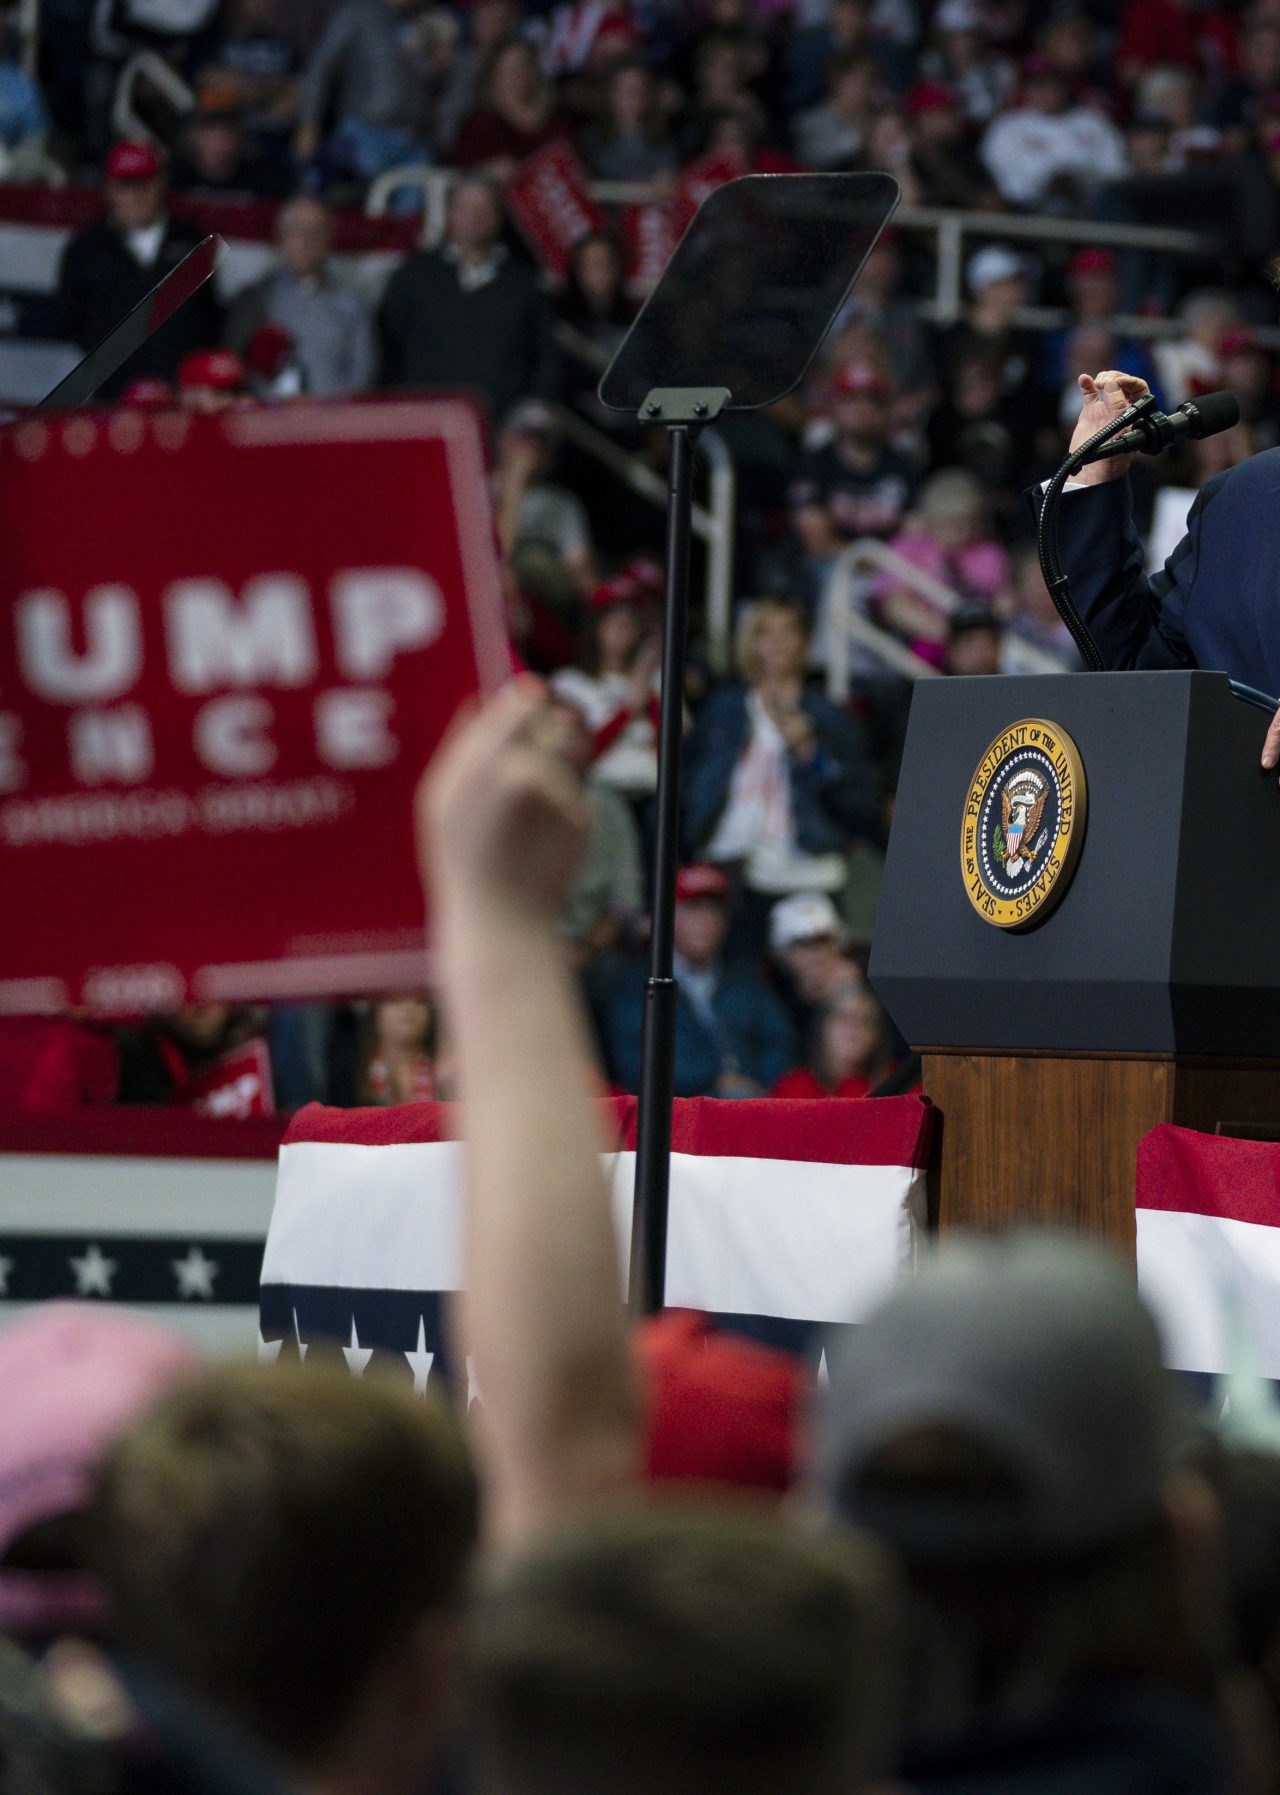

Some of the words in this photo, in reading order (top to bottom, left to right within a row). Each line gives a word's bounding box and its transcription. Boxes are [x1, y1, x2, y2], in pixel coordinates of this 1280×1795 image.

[1029, 728, 1042, 742] OF
[1041, 732, 1056, 754] THE
[967, 726, 1028, 819] PRESIDENT
[1054, 750, 1074, 836] UNITED
[965, 825, 975, 854] THE
[965, 857, 975, 875] OF
[970, 873, 997, 917] SEAL
[1015, 854, 1061, 917] STATES
